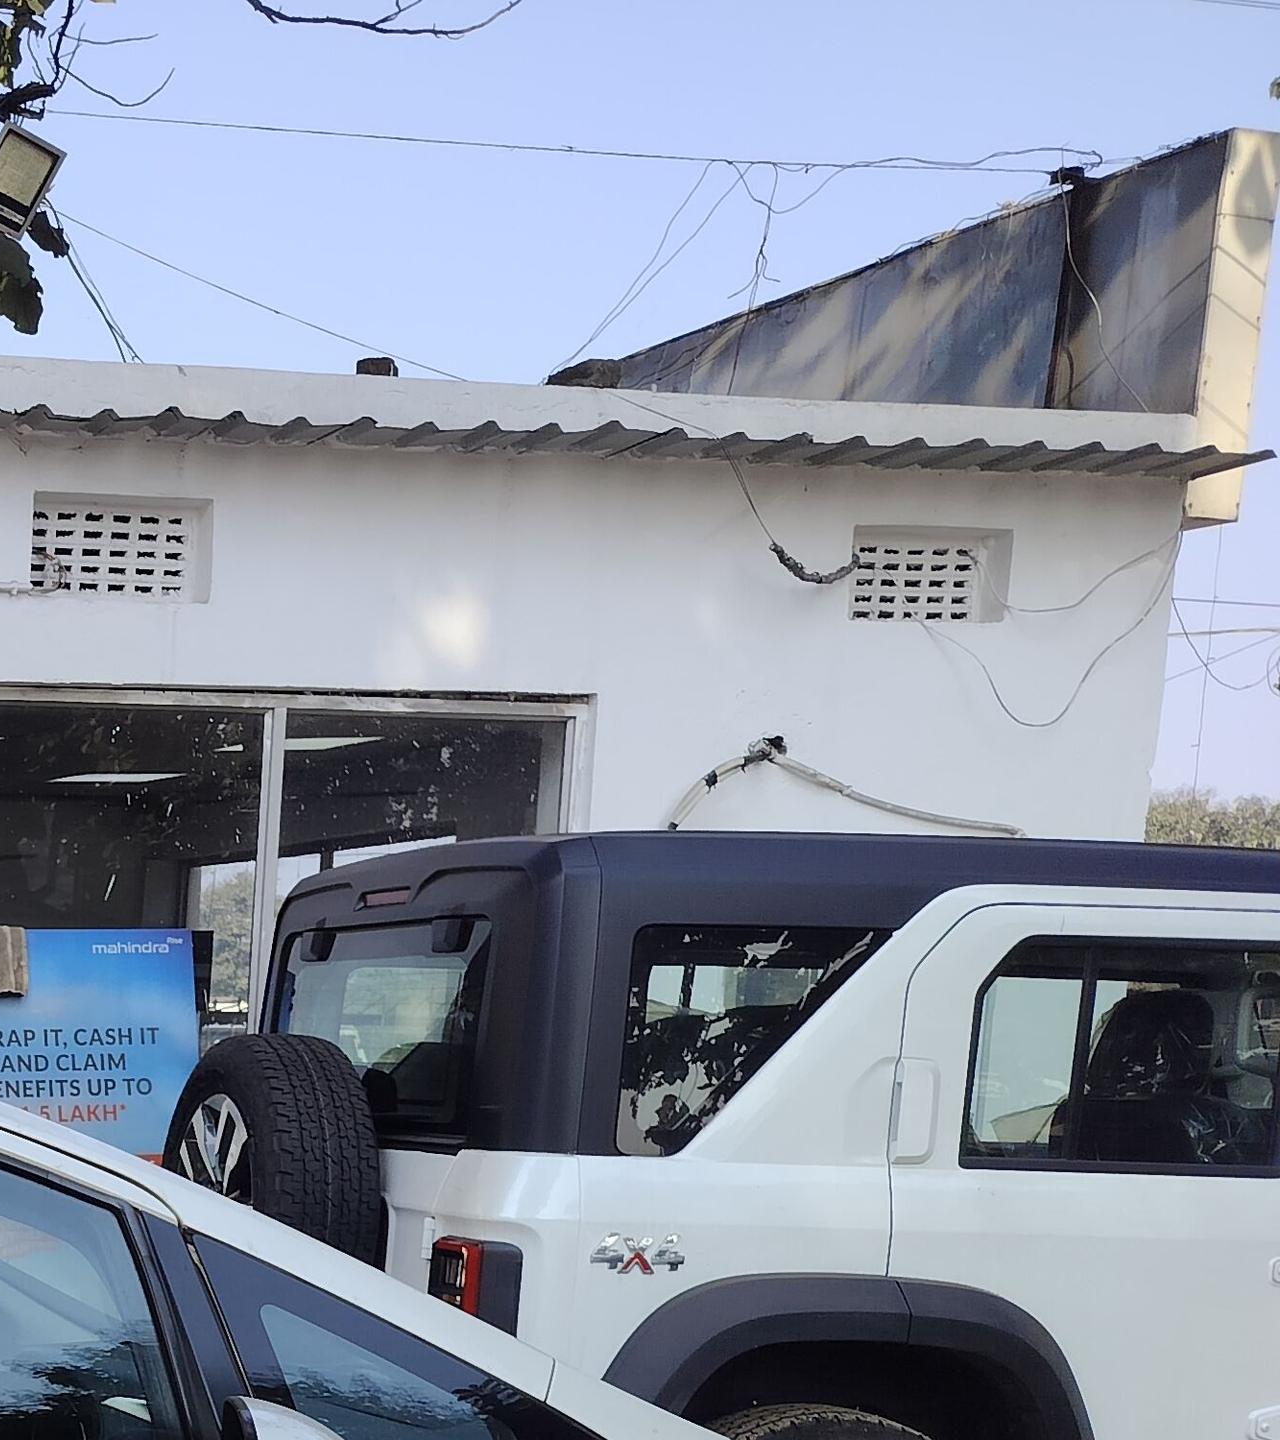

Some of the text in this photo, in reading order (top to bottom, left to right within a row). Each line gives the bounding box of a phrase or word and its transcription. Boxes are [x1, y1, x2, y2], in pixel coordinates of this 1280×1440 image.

[92, 941, 170, 954] mahindra
[43, 1028, 68, 1050] IT,
[73, 1027, 133, 1047] CASH
[140, 1026, 160, 1046] IT
[0, 1052, 126, 1073] AND CLAIM
[88, 1078, 116, 1097] UP
[122, 1077, 153, 1096] TO
